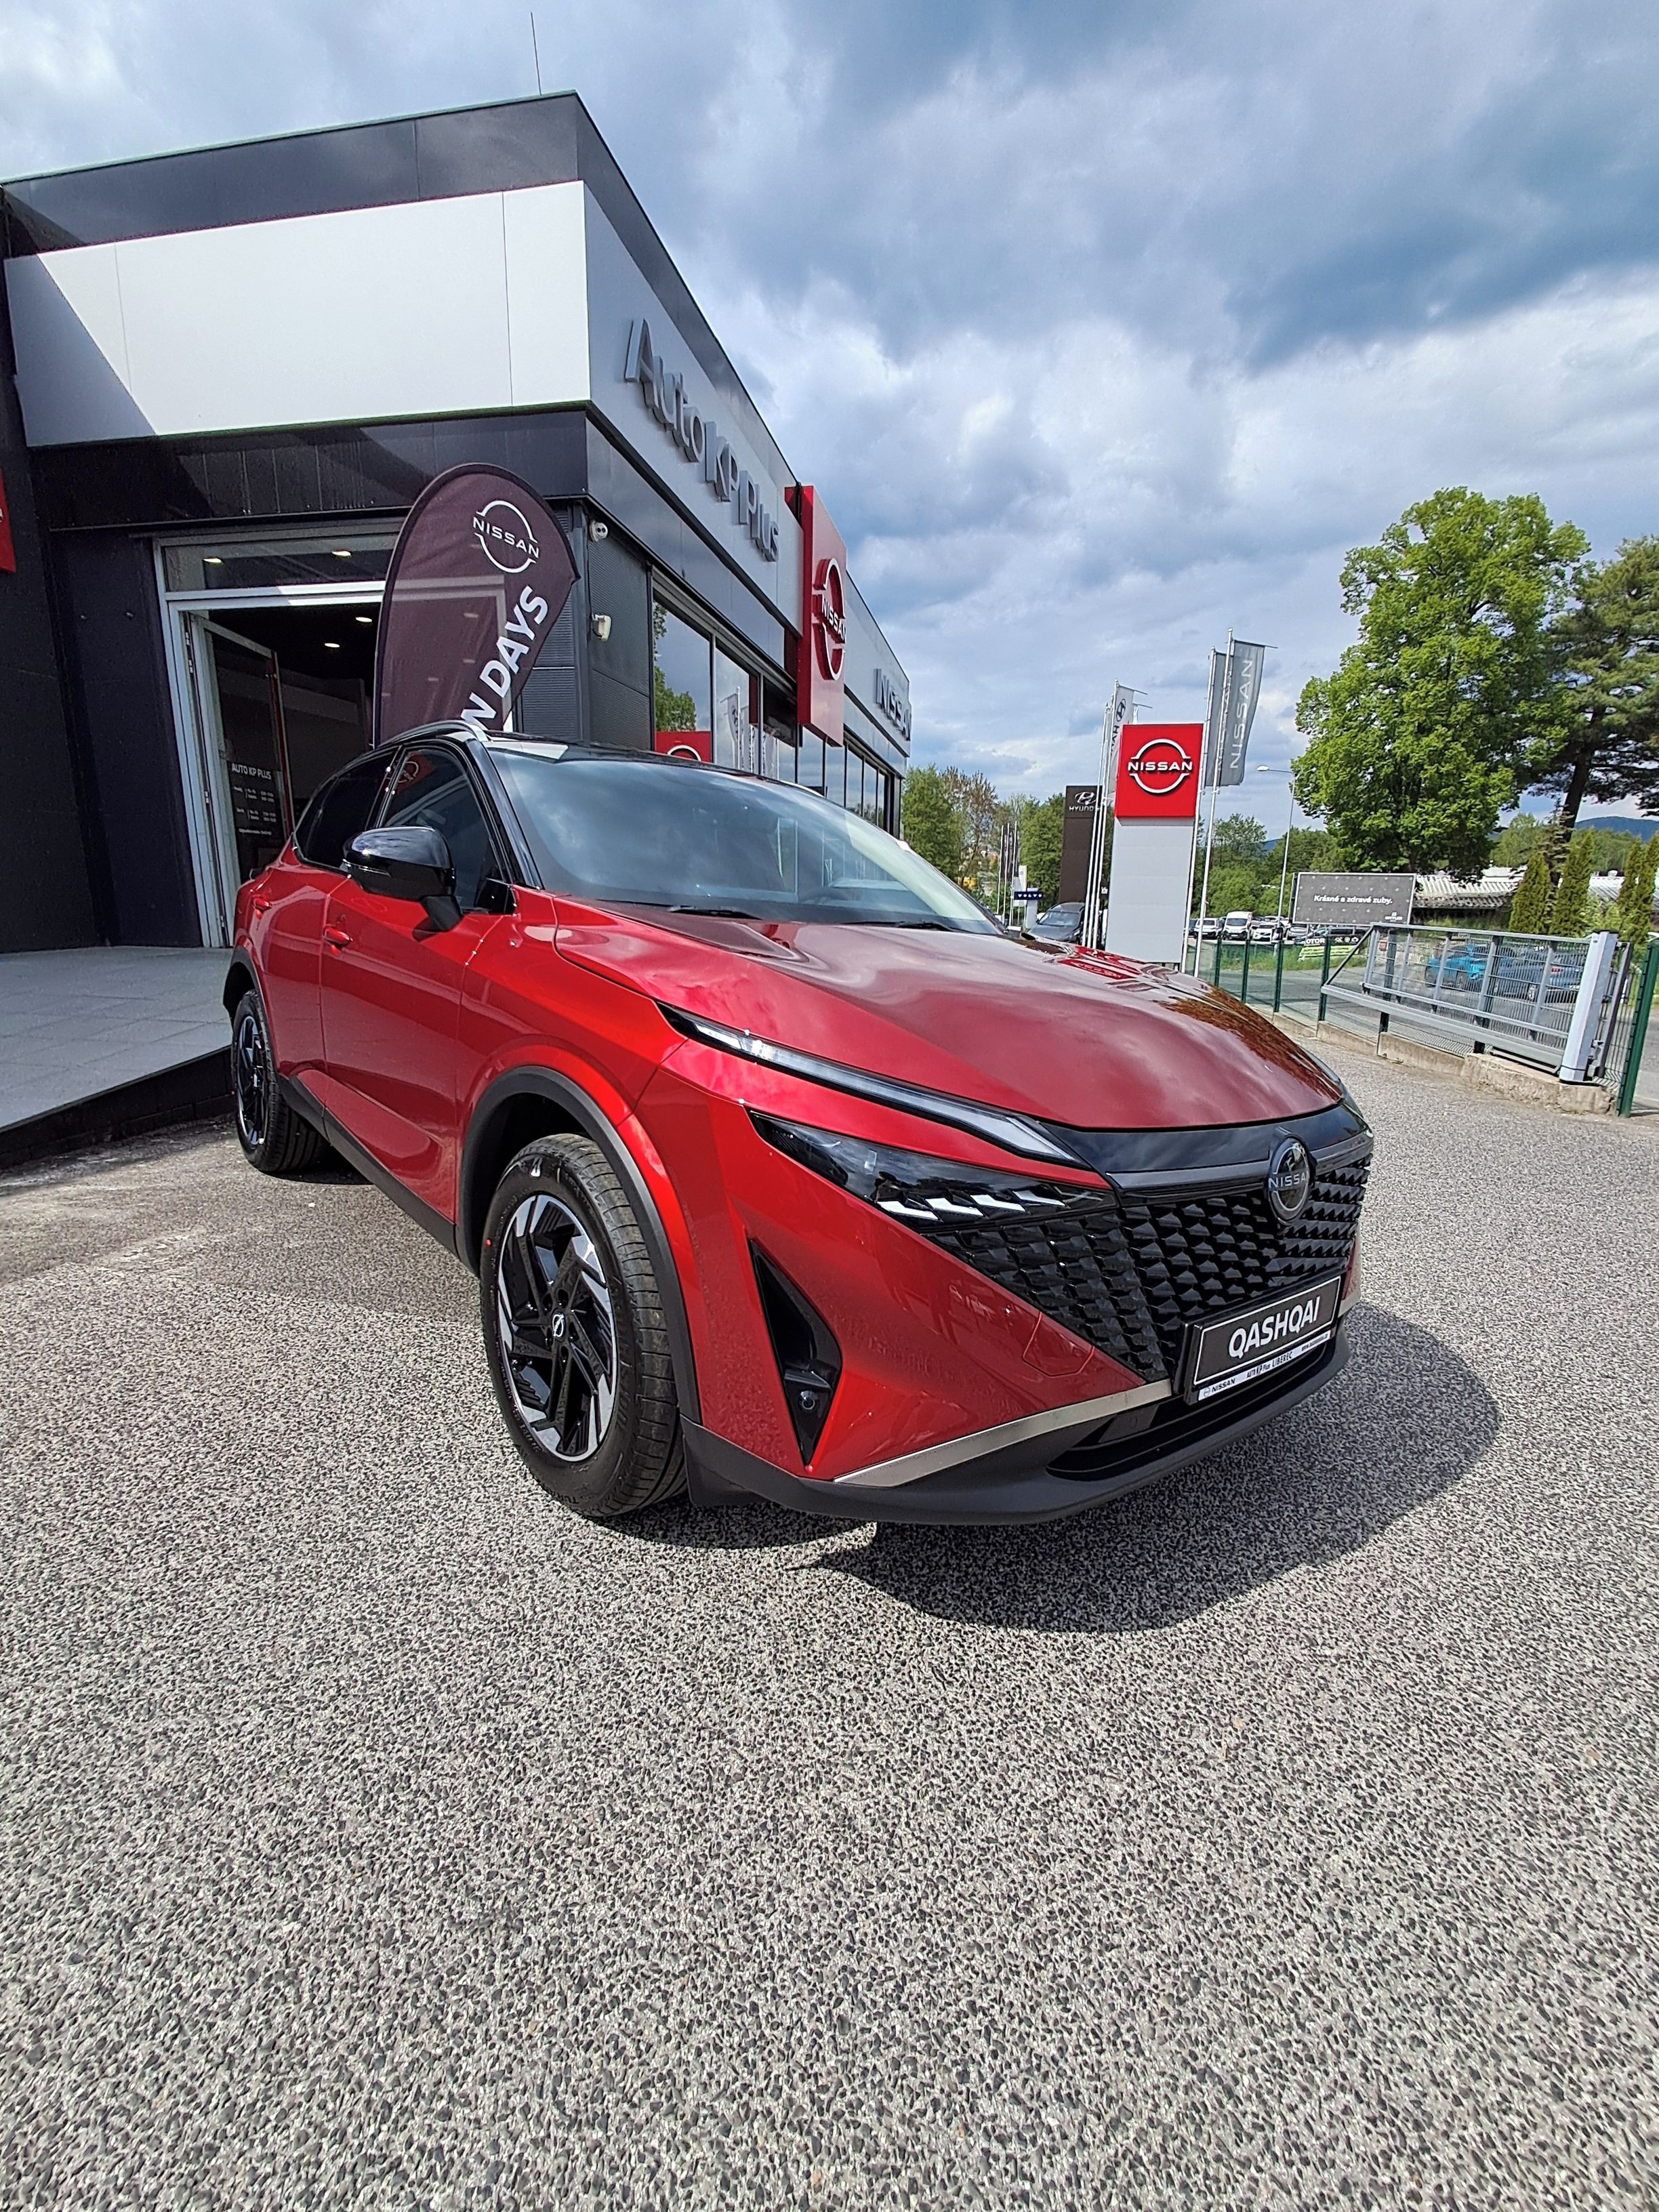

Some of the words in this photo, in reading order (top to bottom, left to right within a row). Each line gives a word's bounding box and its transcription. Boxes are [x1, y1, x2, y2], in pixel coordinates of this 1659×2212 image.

[624, 319, 705, 462] Auto
[705, 422, 739, 501] KP
[739, 470, 779, 562] Plus
[473, 516, 539, 559] NISSAN
[479, 586, 549, 698] DAYS
[821, 596, 846, 644] NISSAN
[874, 668, 912, 741] NISSAN
[1230, 659, 1254, 769] NISSAN
[232, 763, 248, 775] AUTO
[248, 766, 257, 776] KP
[258, 769, 272, 780] PLUS
[1128, 760, 1193, 771] NISSAN
[1313, 895, 1339, 903] Krásné
[1346, 895, 1372, 903] zdravé
[1372, 897, 1393, 905] zuby.
[1228, 1296, 1321, 1359] QASHQAI
[1211, 1378, 1236, 1393] NISSAN
[1272, 1351, 1293, 1368] LIBEREC
